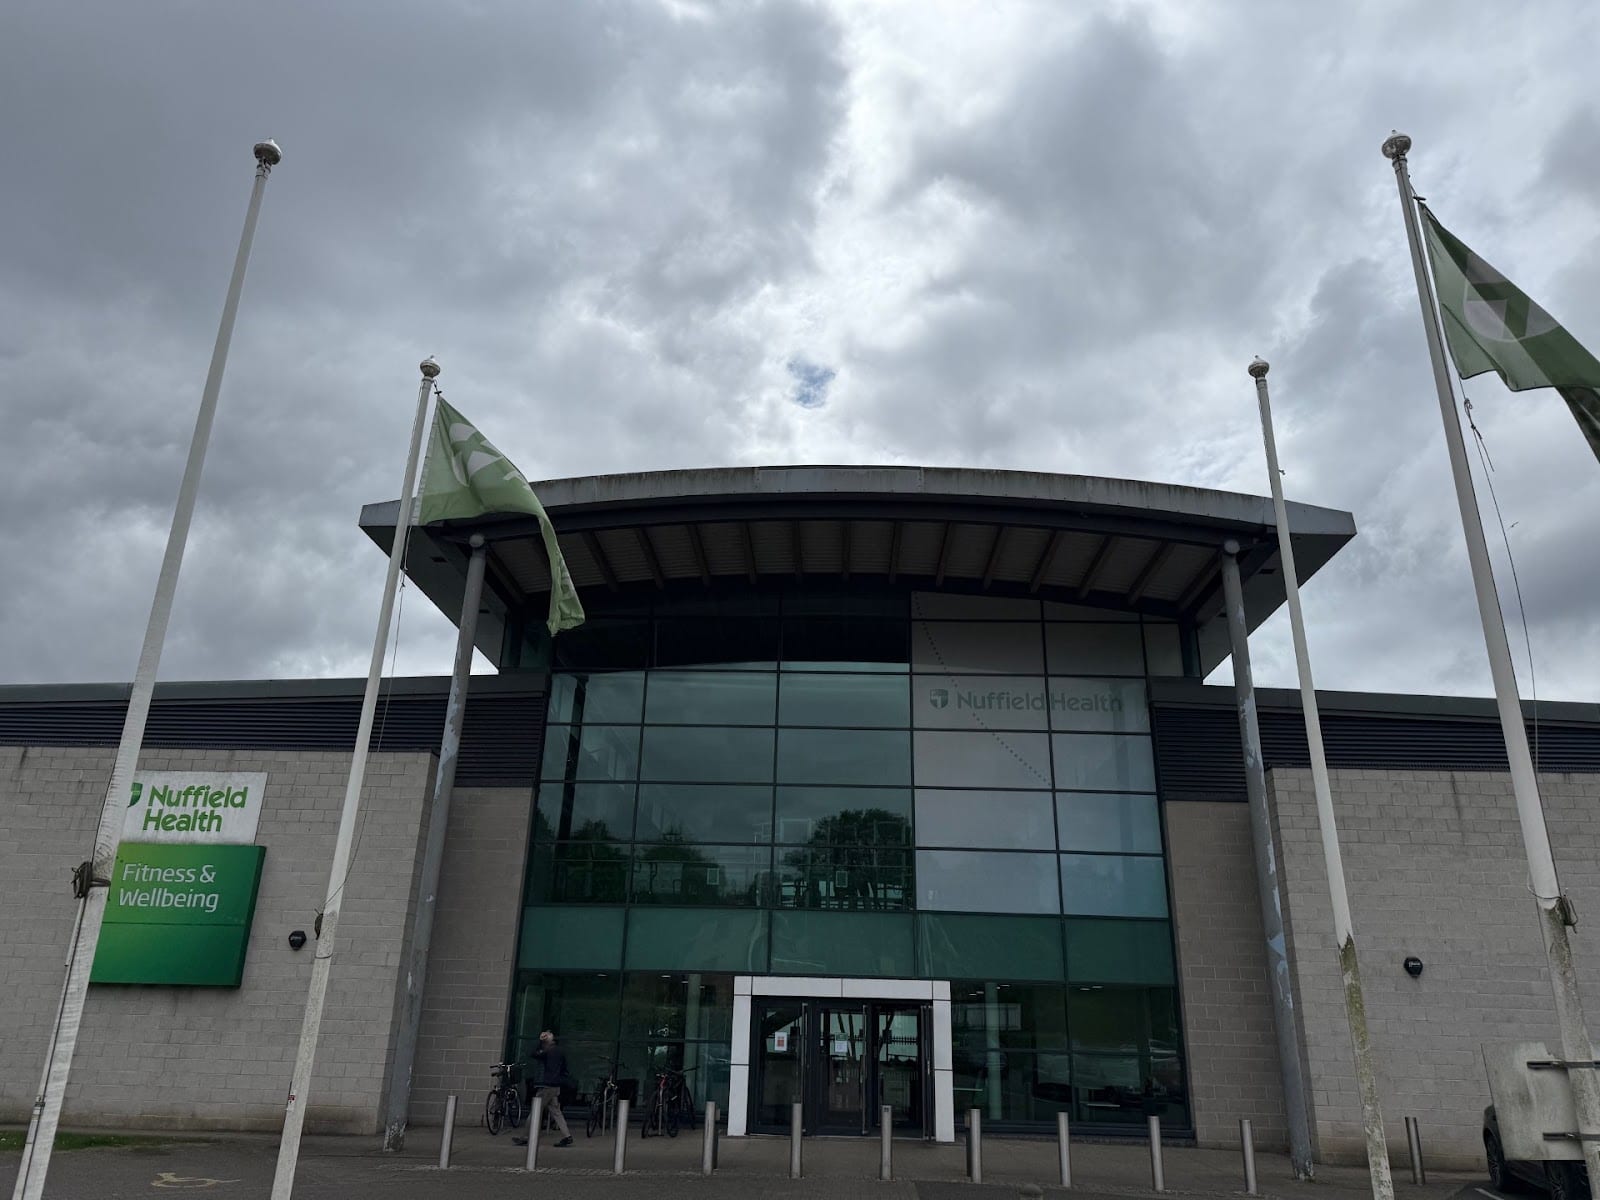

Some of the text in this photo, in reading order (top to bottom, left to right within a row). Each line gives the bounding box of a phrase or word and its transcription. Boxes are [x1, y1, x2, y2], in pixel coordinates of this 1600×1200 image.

[957, 690, 1123, 713] Nuffield Health
[147, 785, 249, 808] Nuffield
[142, 809, 223, 832] Health
[122, 863, 217, 883] Fitness &
[119, 888, 219, 913] Wellbeing
